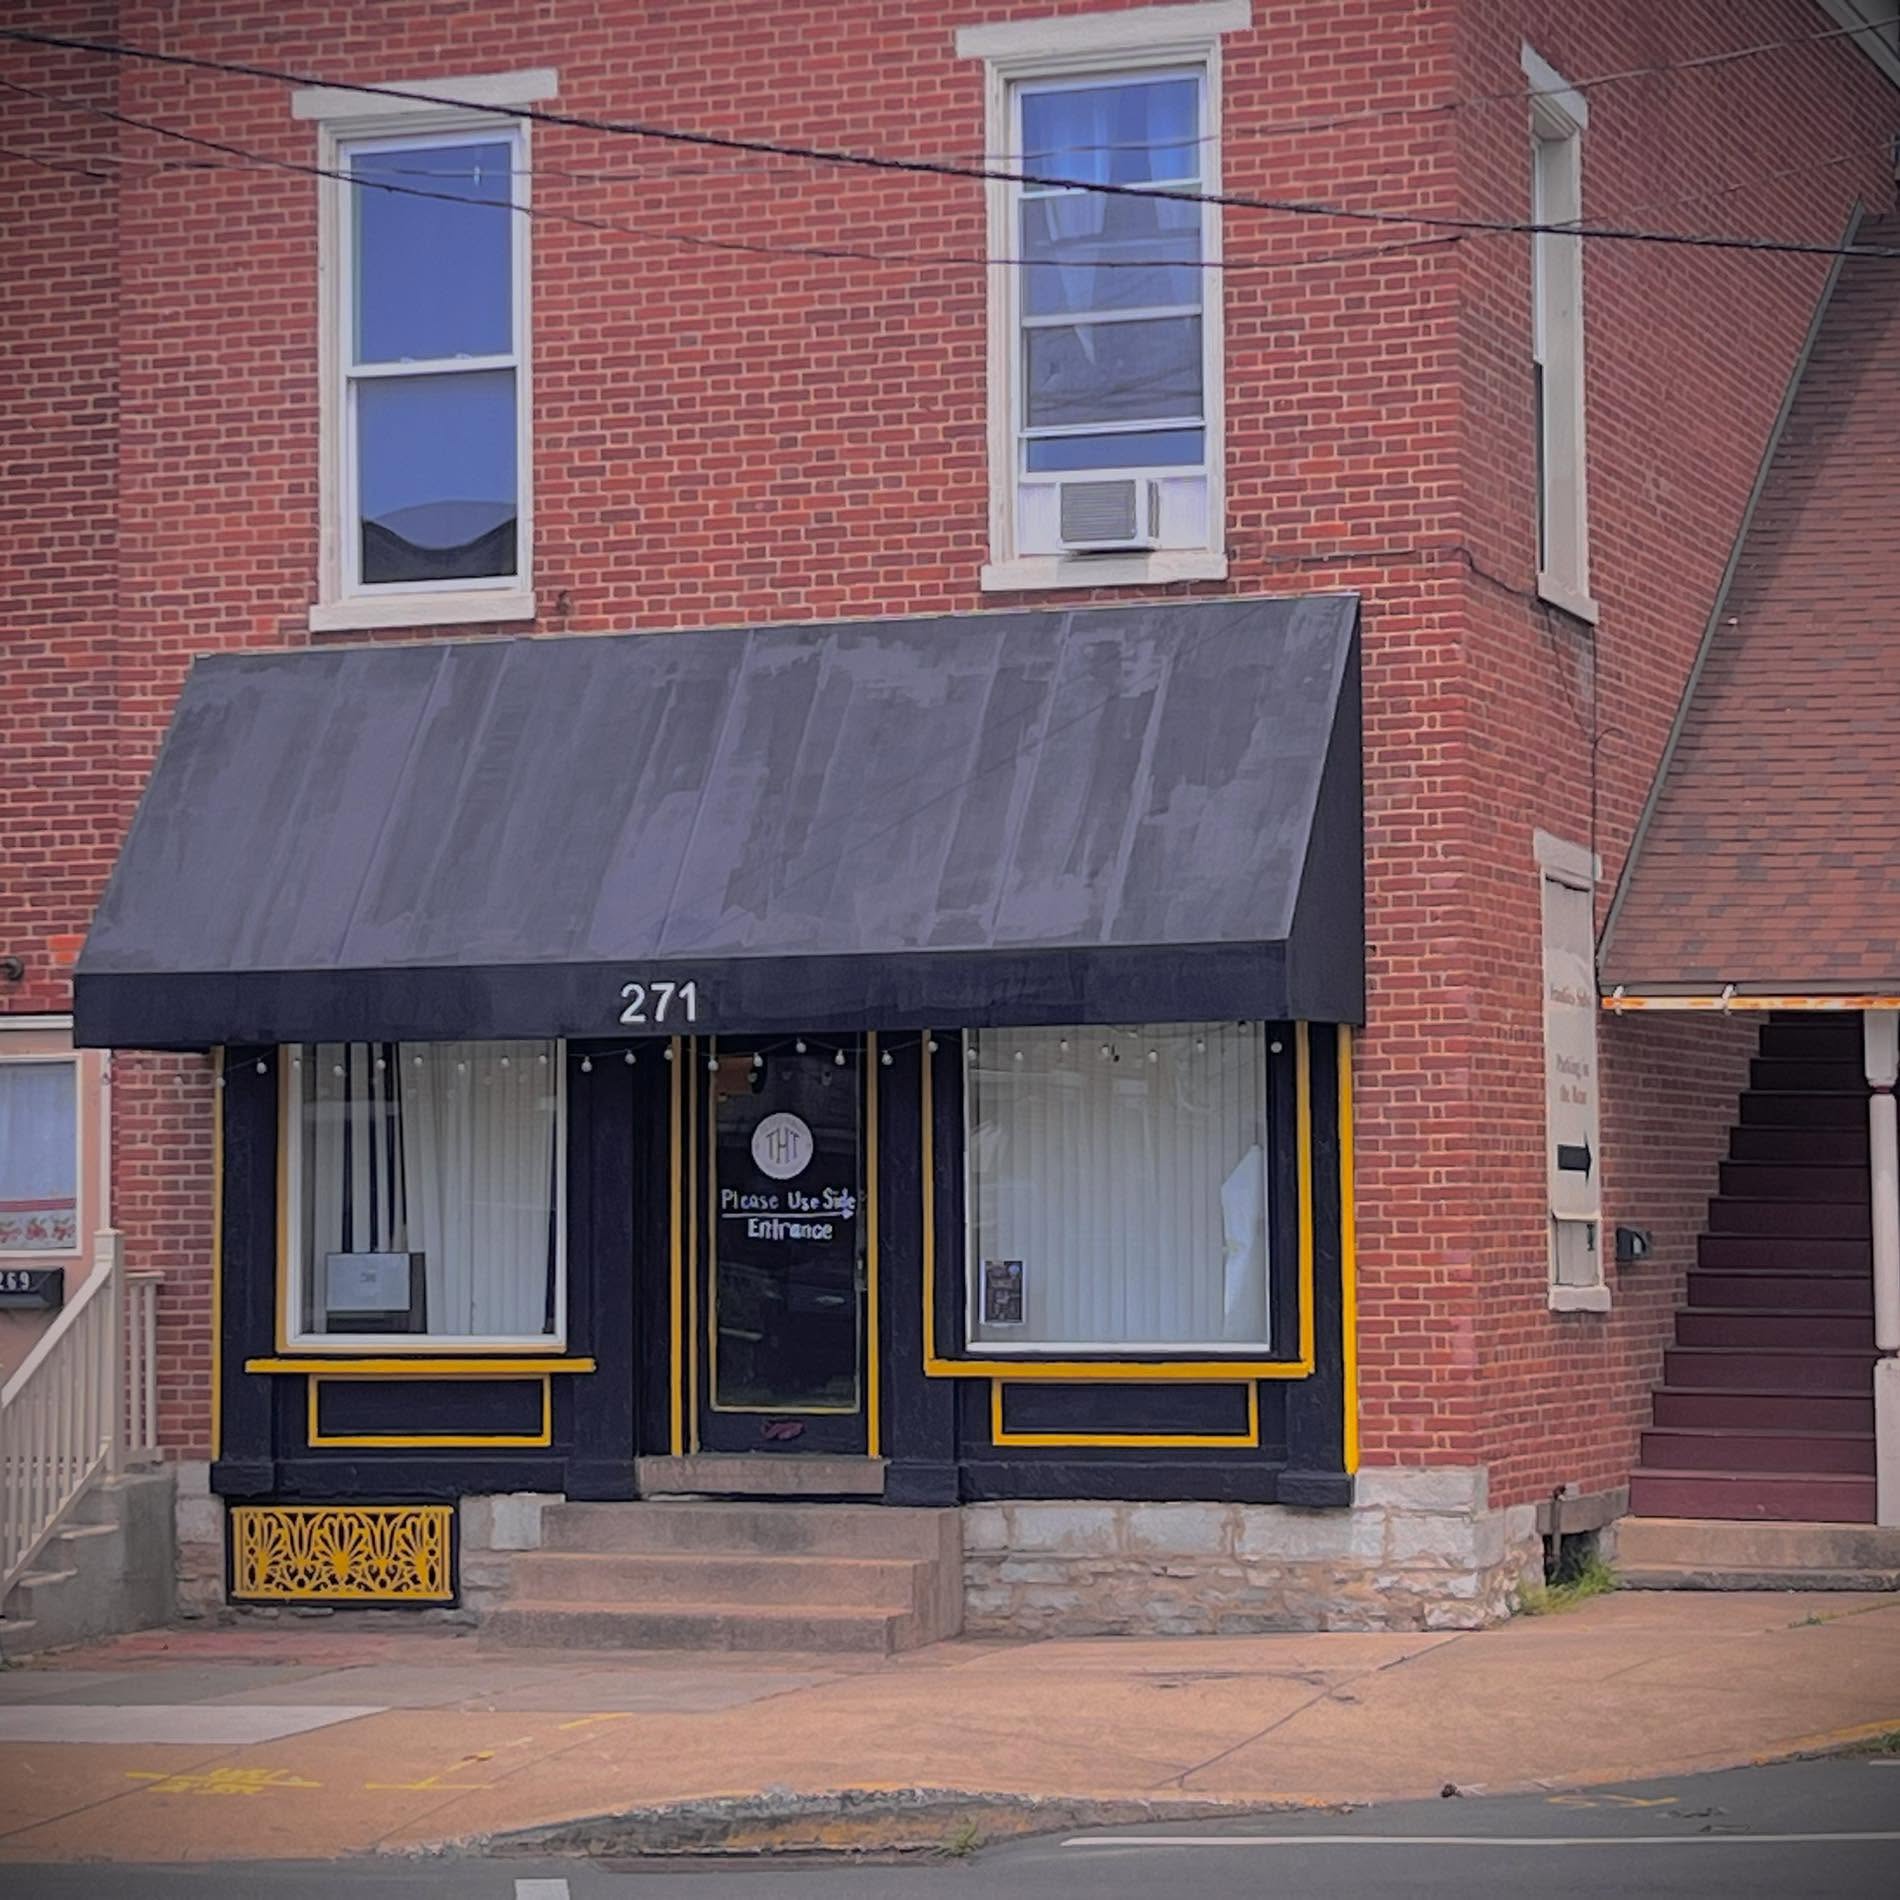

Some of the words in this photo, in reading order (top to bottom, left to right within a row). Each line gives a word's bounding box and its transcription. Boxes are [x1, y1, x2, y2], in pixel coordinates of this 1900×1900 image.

[620, 981, 697, 1023] 271
[765, 1127, 800, 1164] THT
[721, 1188, 779, 1210] Please
[787, 1190, 820, 1212] Use
[747, 1218, 833, 1240] Entrance
